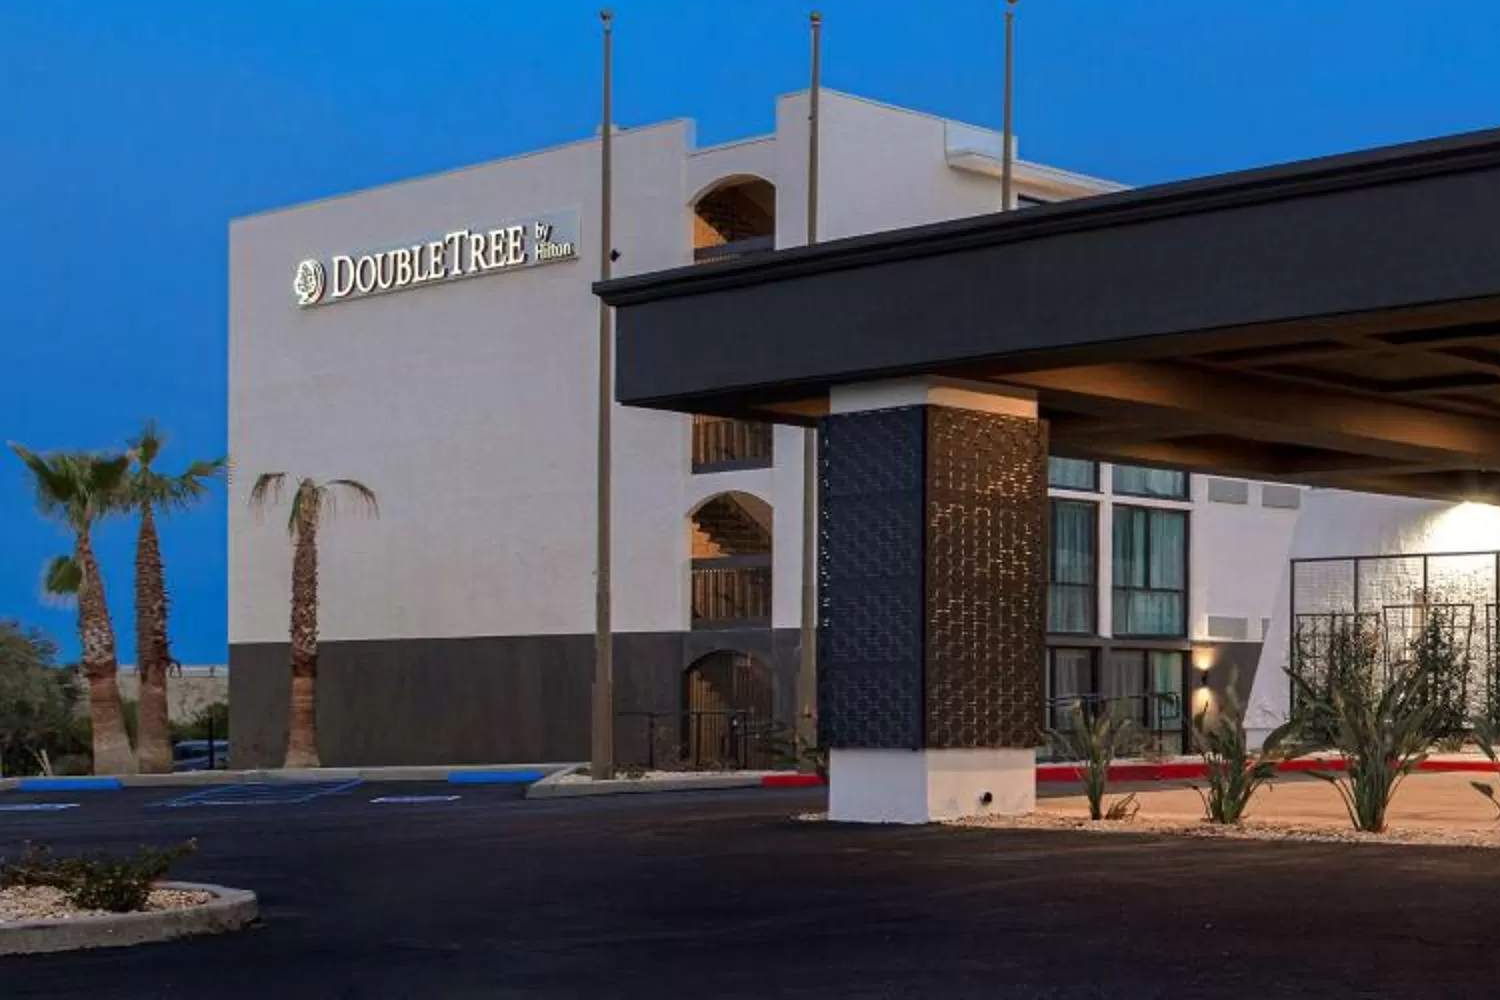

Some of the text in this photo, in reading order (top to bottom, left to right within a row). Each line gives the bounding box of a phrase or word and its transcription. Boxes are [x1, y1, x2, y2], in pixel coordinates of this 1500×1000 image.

[535, 221, 551, 241] by
[331, 225, 526, 297] DOUBLETREE
[535, 240, 572, 261] Hilton
